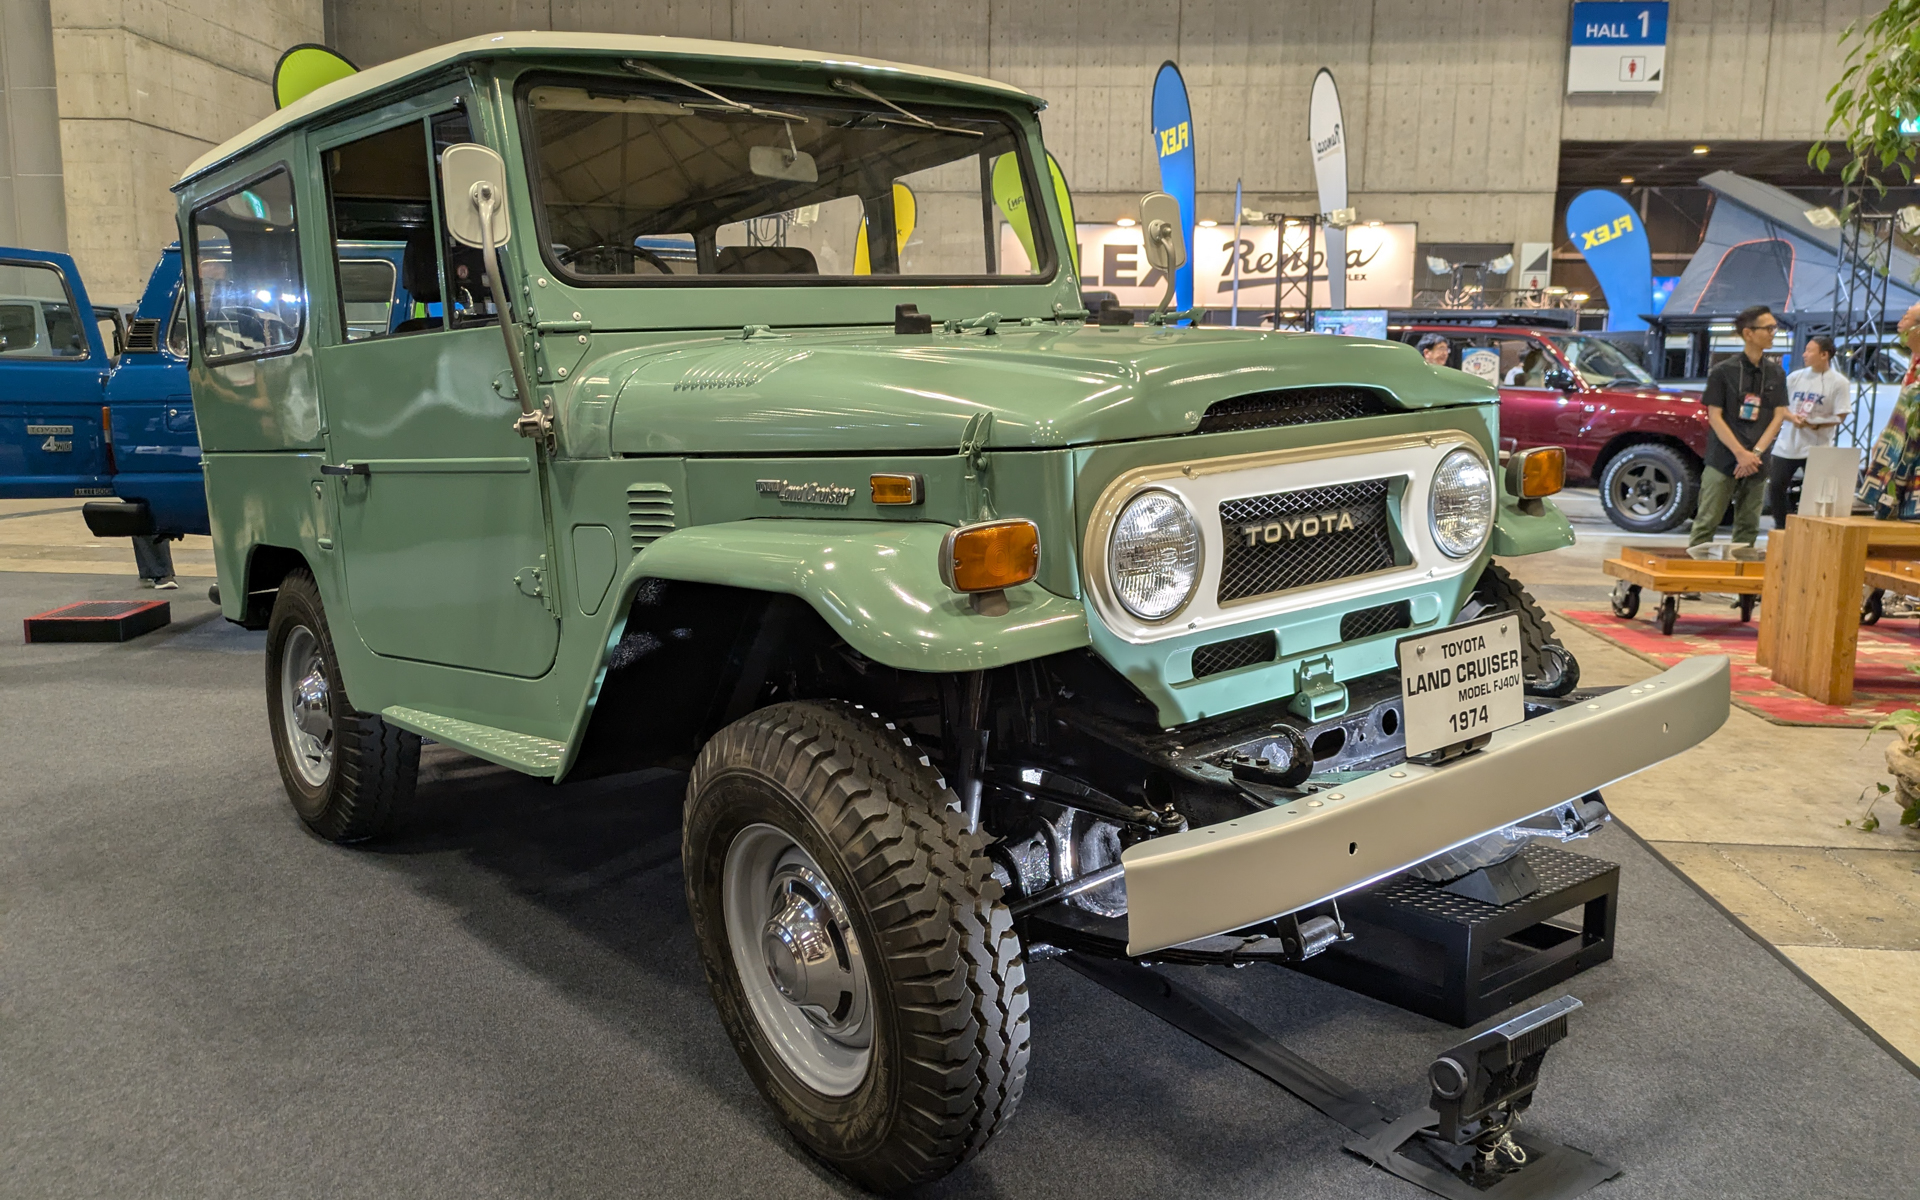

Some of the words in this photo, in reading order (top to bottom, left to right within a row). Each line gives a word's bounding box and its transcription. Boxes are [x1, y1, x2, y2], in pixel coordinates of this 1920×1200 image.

[1586, 23, 1629, 38] HALL
[1637, 10, 1649, 38] 1
[1077, 243, 1169, 287] LE
[1221, 239, 1383, 277] Renoa
[1346, 273, 1367, 281] LEX
[1793, 391, 1826, 406] FLEX
[29, 426, 72, 434] TOYOTA
[806, 482, 855, 505] Cruiser
[1245, 512, 1355, 546] TOYOTA
[1441, 635, 1486, 659] TOYOTA
[1407, 668, 1451, 697] LAND
[1456, 649, 1519, 683] CRUISER
[1458, 682, 1491, 702] MODEL
[1493, 673, 1520, 692] FJ40V
[1449, 704, 1489, 733] 1974
